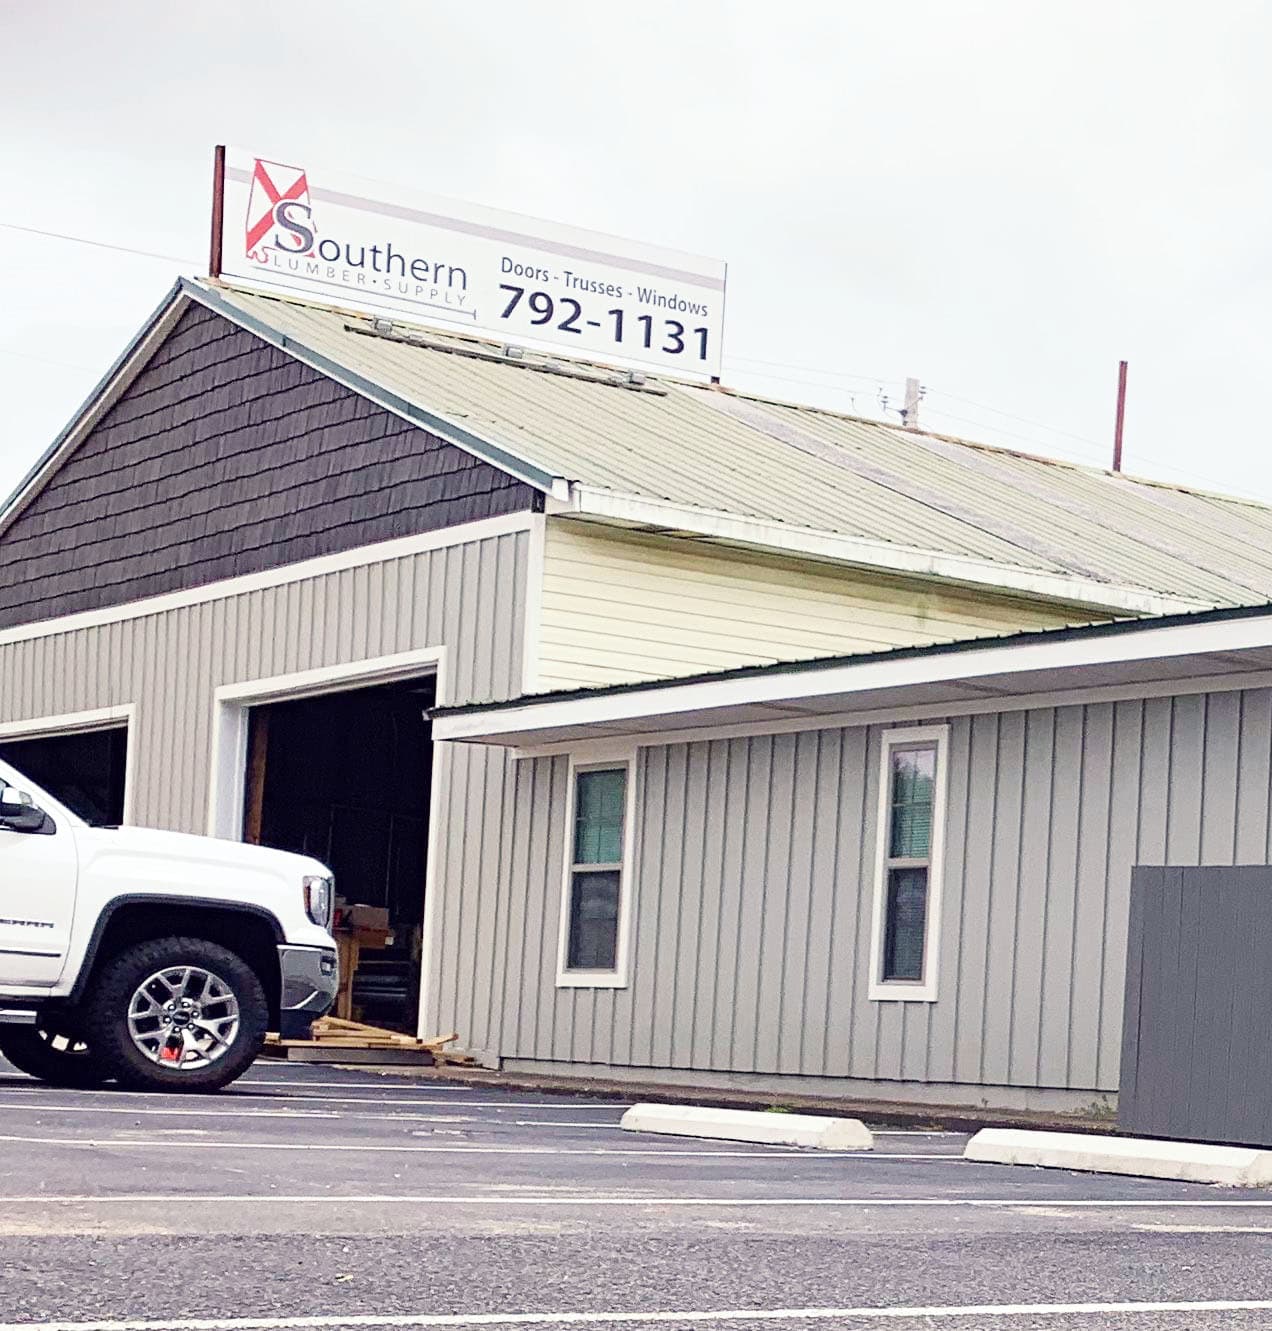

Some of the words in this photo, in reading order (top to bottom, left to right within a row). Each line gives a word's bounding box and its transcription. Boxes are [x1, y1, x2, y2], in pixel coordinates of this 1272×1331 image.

[274, 201, 468, 290] Southern
[499, 283, 710, 361] 792-1131
[501, 257, 549, 282] Doors
[564, 271, 623, 298] Trusses
[637, 286, 709, 317] Windows
